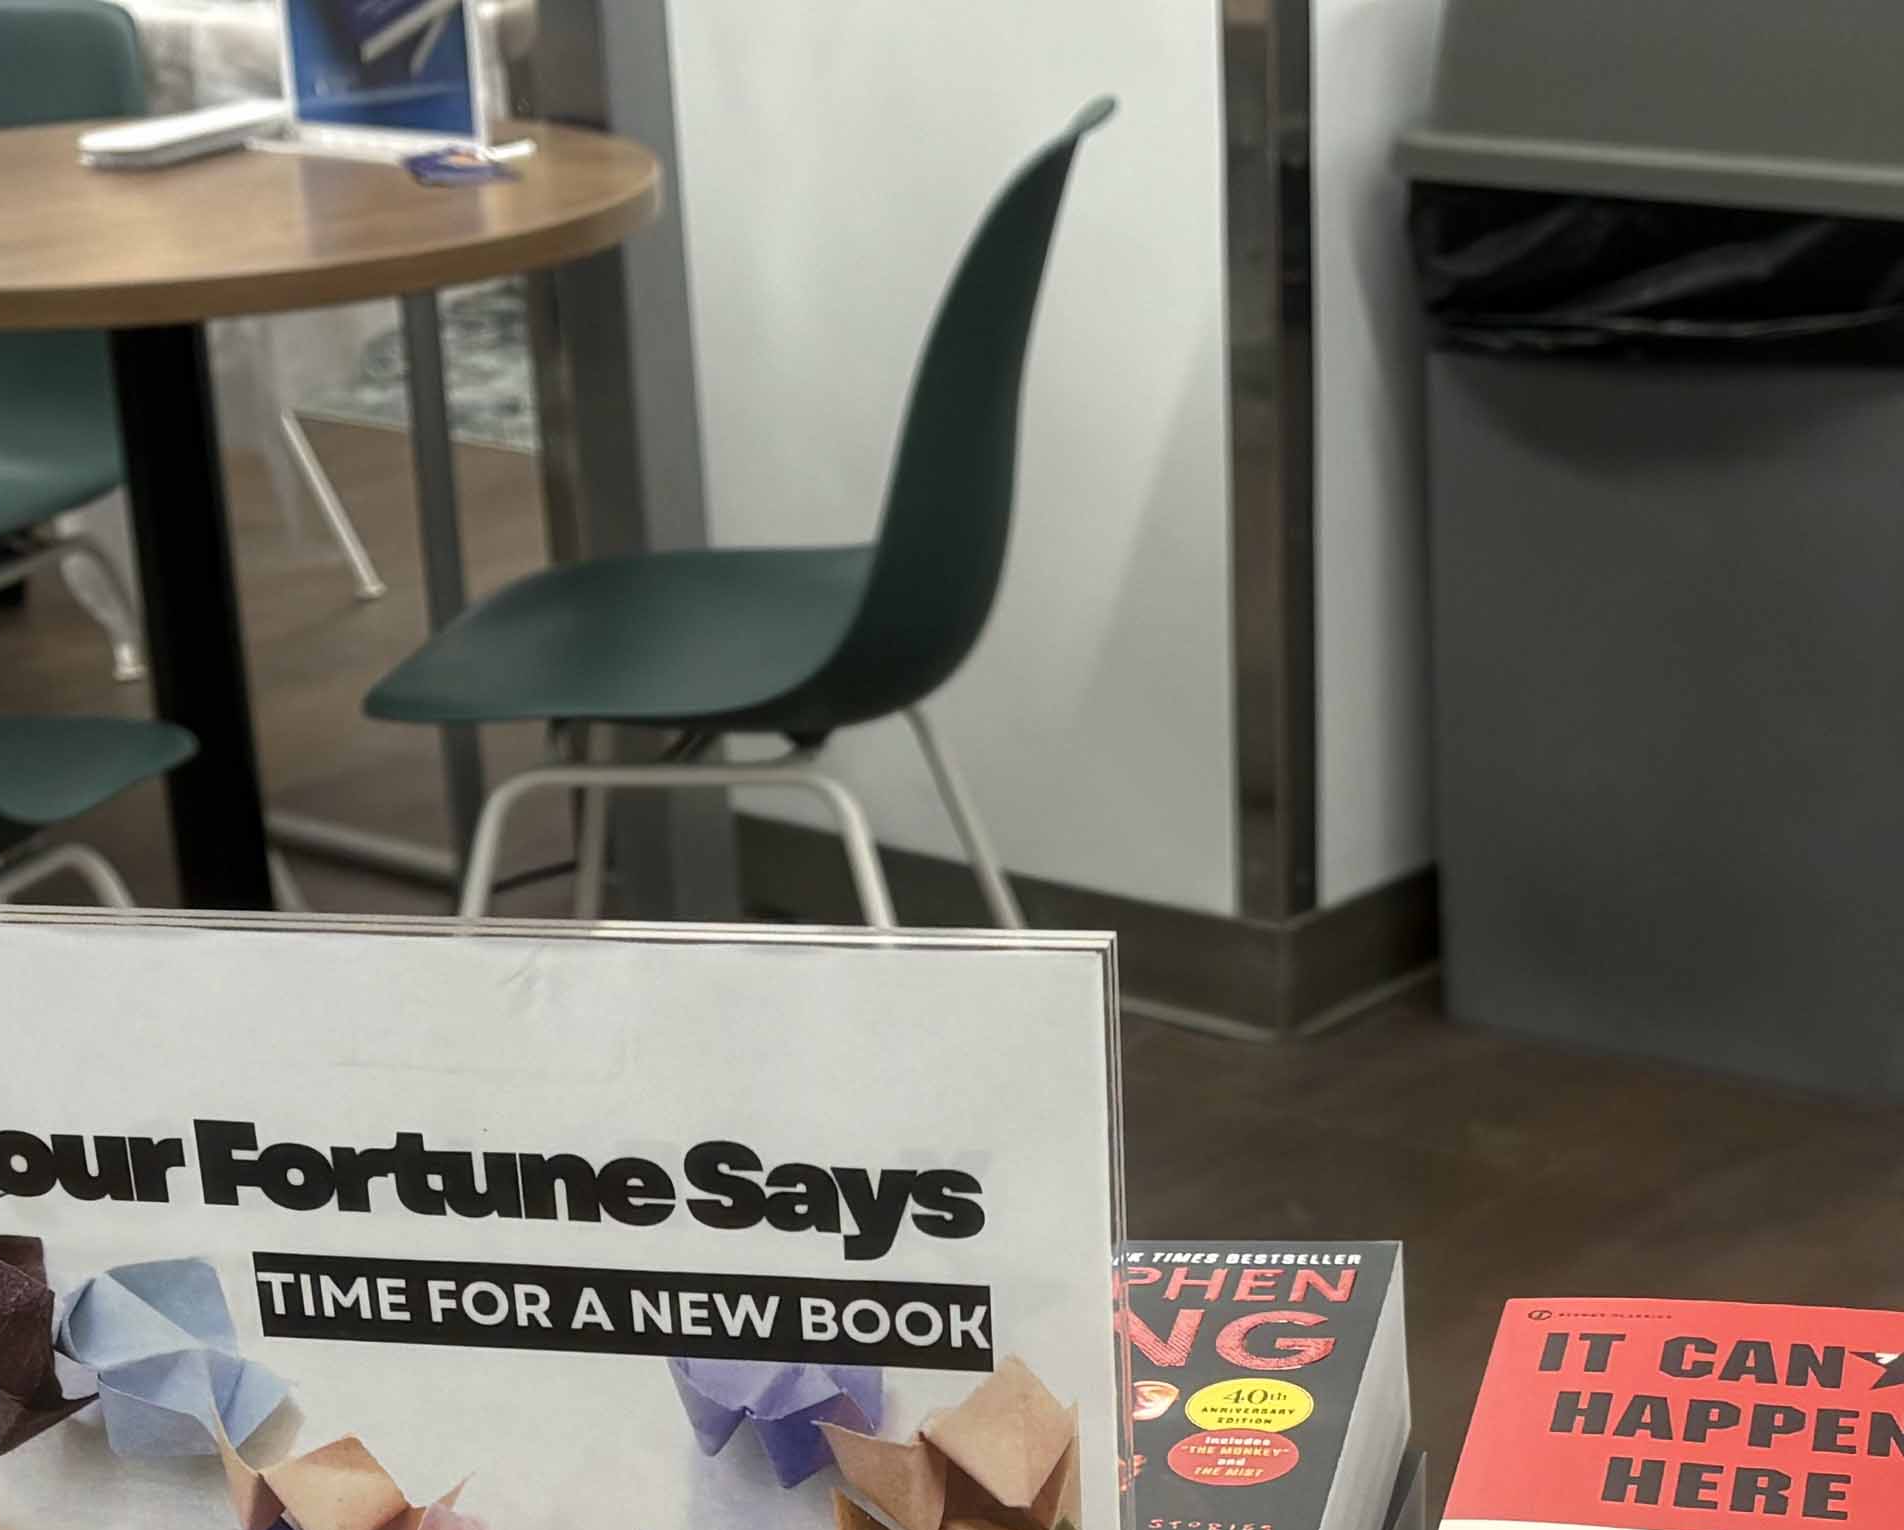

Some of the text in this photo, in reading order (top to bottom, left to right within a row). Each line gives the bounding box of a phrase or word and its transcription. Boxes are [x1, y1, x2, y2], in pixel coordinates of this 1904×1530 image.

[191, 1118, 680, 1226] Fortune
[681, 1140, 987, 1262] Says
[1152, 1252, 1219, 1264] TIMES
[1226, 1253, 1362, 1265] BESTSELLER
[258, 1268, 993, 1351] TIME FOR A NEW BOOK
[1538, 1332, 1626, 1373] IT
[1600, 1456, 1852, 1521] HERE
